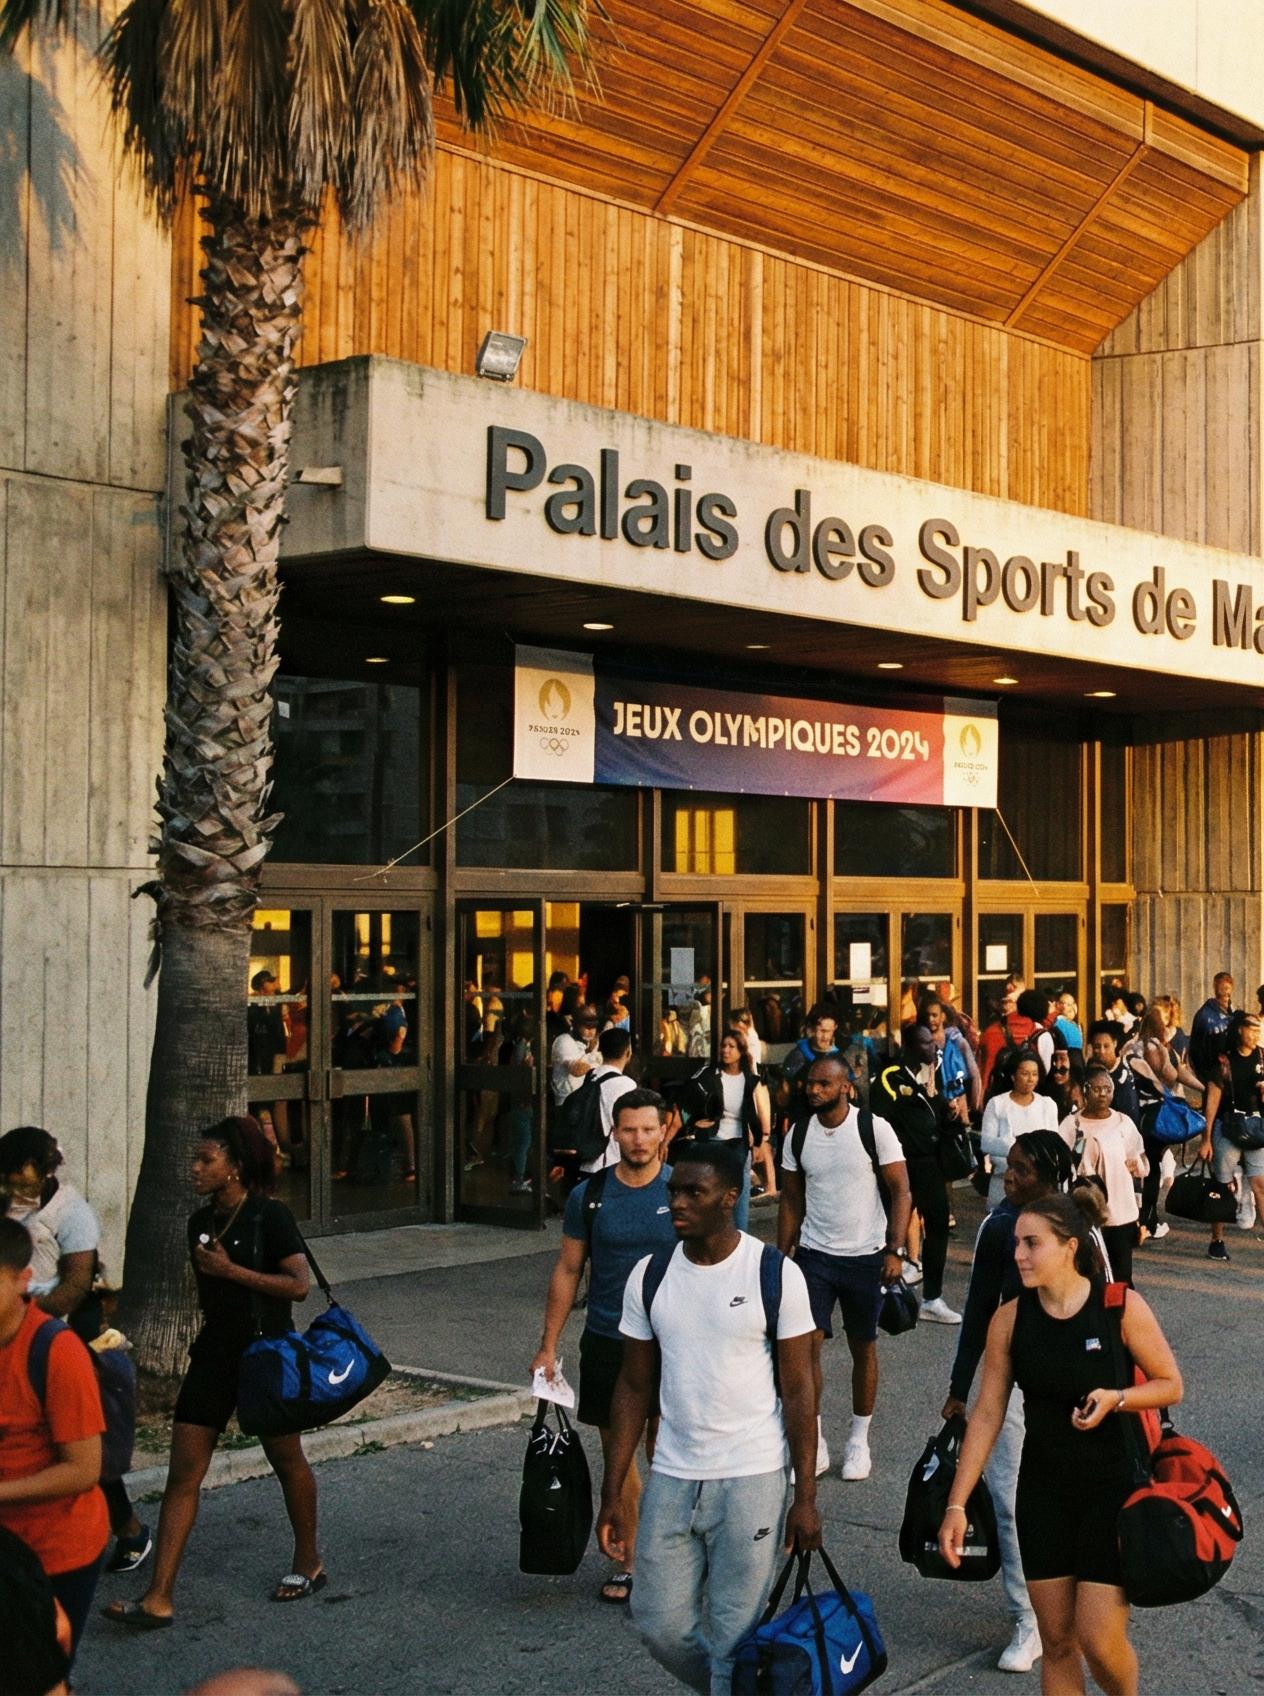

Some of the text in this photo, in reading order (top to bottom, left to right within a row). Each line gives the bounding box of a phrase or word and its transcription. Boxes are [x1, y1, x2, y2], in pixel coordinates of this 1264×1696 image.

[487, 425, 739, 560] Palais
[764, 489, 895, 587] des
[917, 518, 1116, 626] Sports
[1132, 566, 1196, 639] de
[613, 702, 929, 760] JEUX OLYMPIQUES 2024
